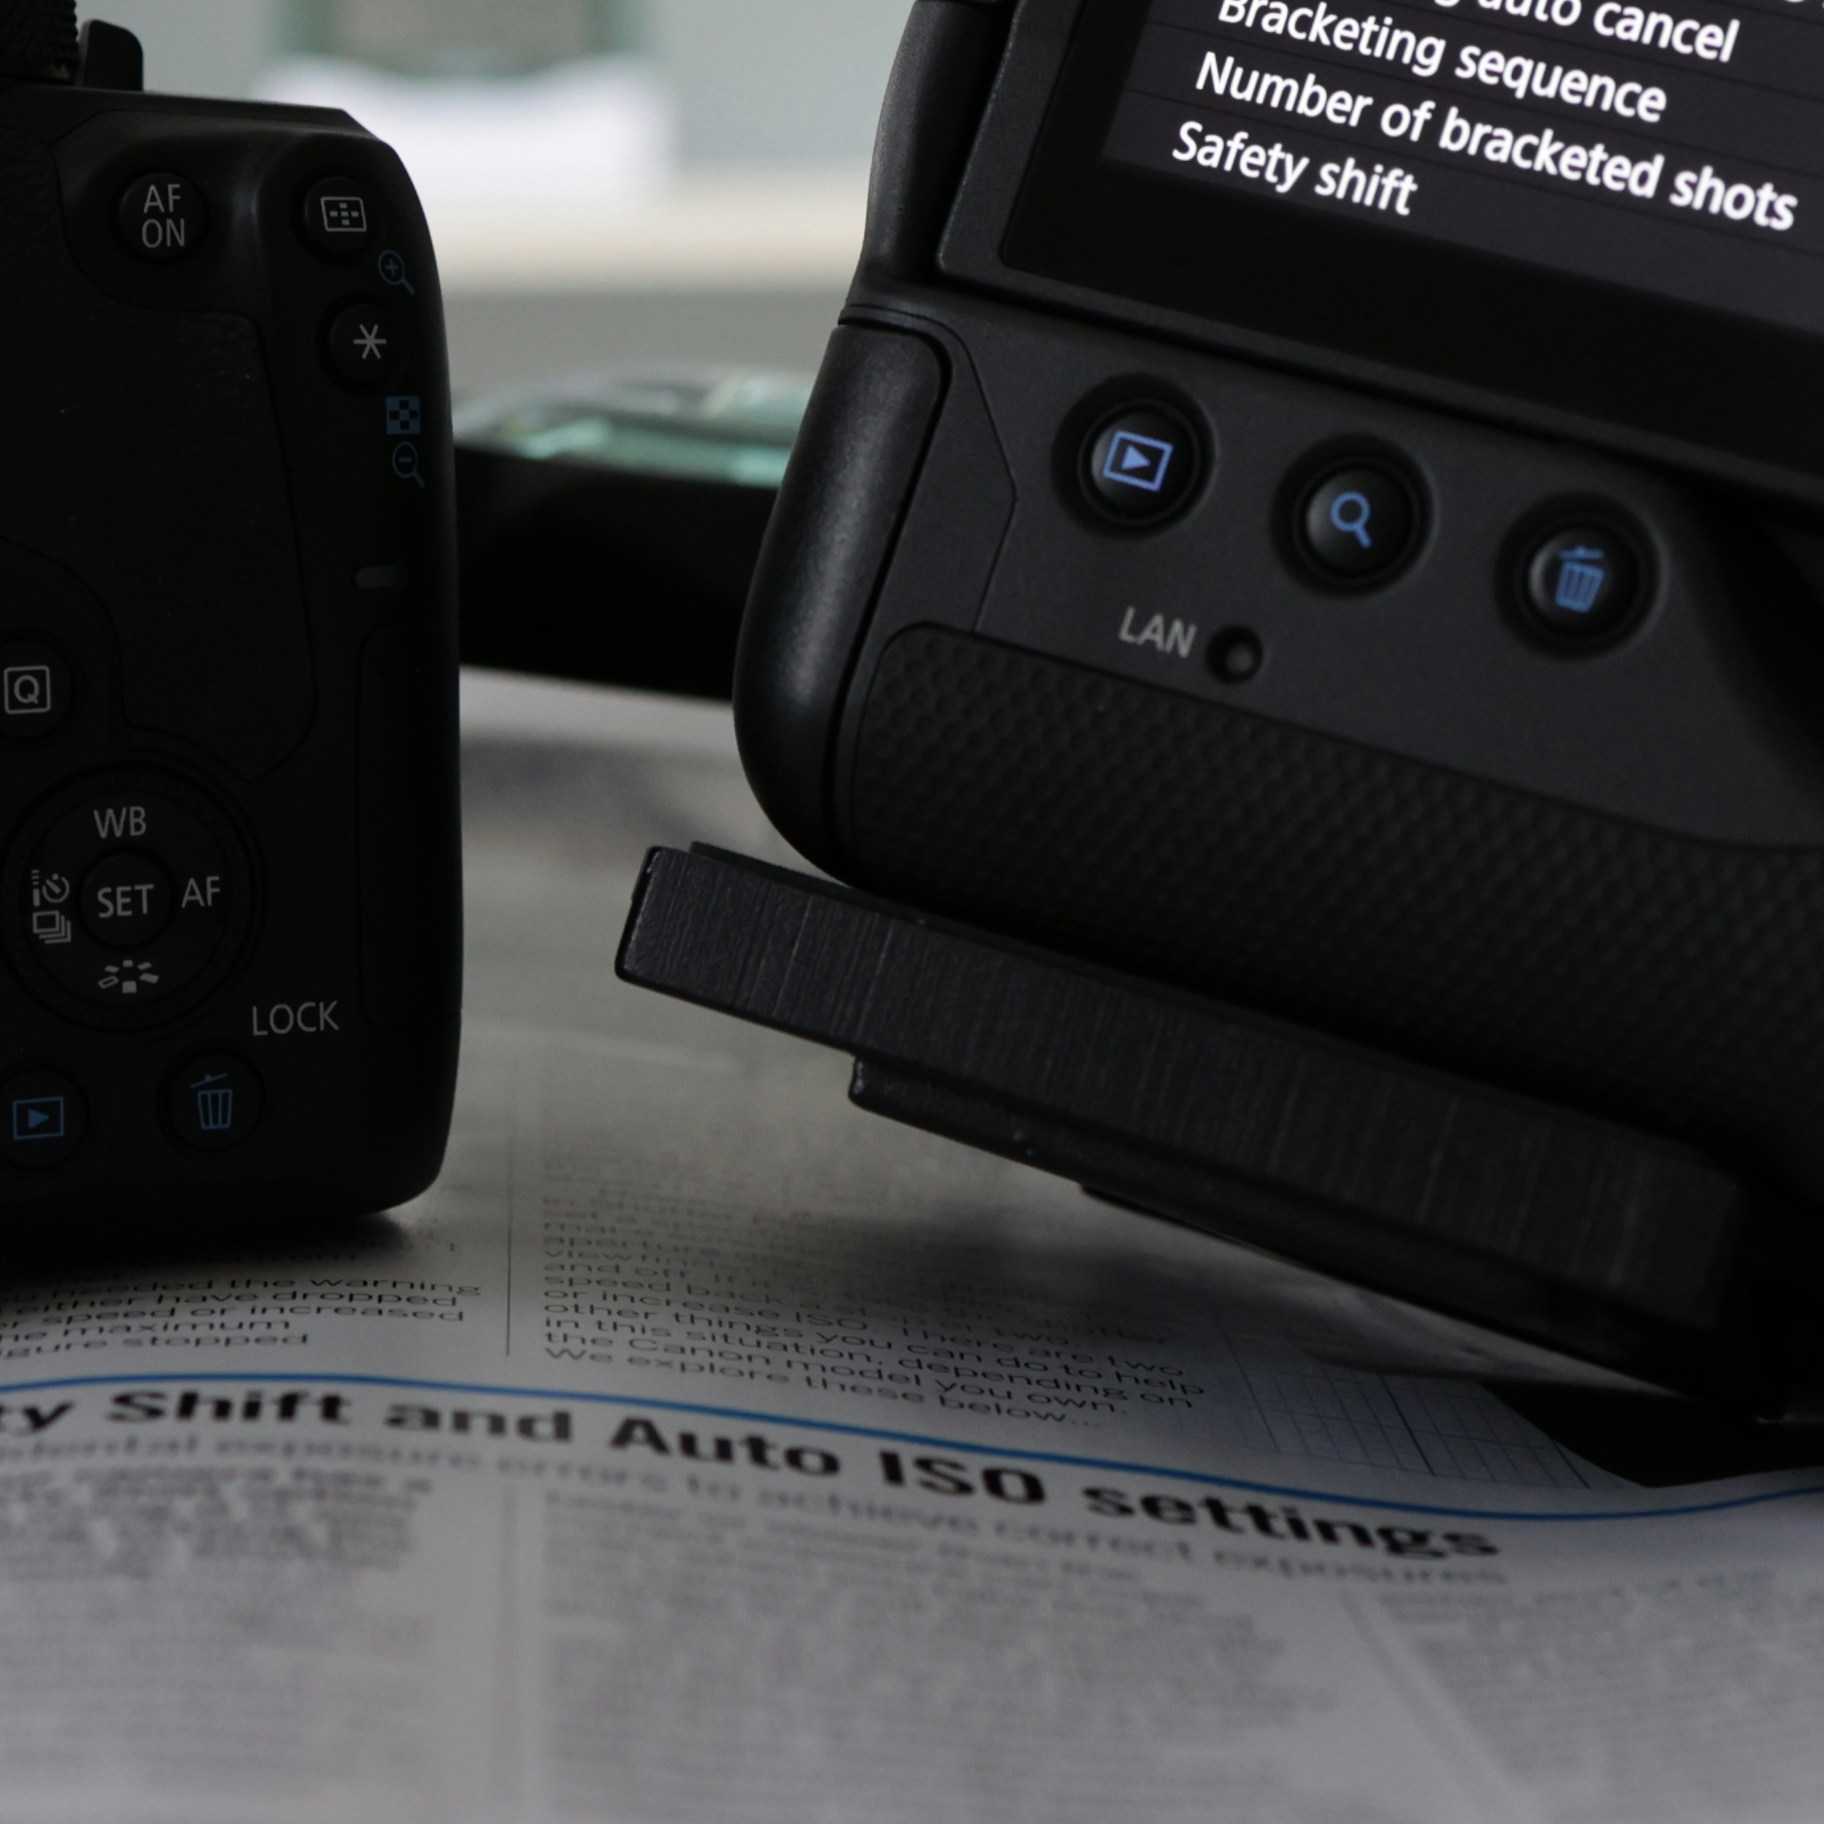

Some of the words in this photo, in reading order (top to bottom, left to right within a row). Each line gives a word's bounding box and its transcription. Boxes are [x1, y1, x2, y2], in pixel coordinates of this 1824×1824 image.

[1593, 1, 1741, 64] cancel
[1455, 45, 1668, 124] sequence
[1194, 51, 1374, 130] Number
[1380, 100, 1436, 143] of
[1439, 106, 1665, 199] bracketed
[1668, 166, 1799, 233] shots
[1172, 120, 1310, 195] Safety
[1314, 158, 1419, 217] shift
[141, 183, 183, 214] AF
[141, 216, 187, 250] ON
[1119, 604, 1197, 659] LAN
[92, 805, 148, 838] WB
[97, 883, 155, 919] SET
[180, 875, 222, 909] AF
[251, 1000, 340, 1037] LOCK
[157, 1291, 258, 1304] have
[272, 1290, 457, 1307] dropped
[229, 1278, 296, 1290] the
[309, 1278, 481, 1297] warning
[544, 1275, 672, 1293] speed
[42, 1307, 175, 1326] speed
[190, 1306, 238, 1317] or
[250, 1304, 464, 1322] increased
[64, 1320, 291, 1336] maximum
[544, 1288, 589, 1300] or
[601, 1289, 781, 1320] increase
[1028, 1347, 1094, 1364] are
[1107, 1355, 1184, 1377] two
[122, 1333, 308, 1349] stopped
[544, 1302, 658, 1321] other
[672, 1311, 804, 1340] things
[815, 1331, 894, 1351] you
[907, 1343, 983, 1364] can
[995, 1355, 1049, 1373] do
[1062, 1363, 1104, 1380] to
[1114, 1370, 1206, 1396] help
[544, 1316, 580, 1330] in
[596, 1319, 672, 1338] this
[897, 1356, 1129, 1402] depending
[1139, 1391, 1194, 1409] on
[544, 1331, 614, 1347] the
[627, 1338, 772, 1366] Canon
[785, 1358, 923, 1387] model
[935, 1379, 1014, 1401] you
[1026, 1390, 1129, 1416] own.
[544, 1347, 613, 1364] We
[627, 1356, 790, 1385] explore
[804, 1376, 926, 1405] these
[105, 1389, 352, 1427] Shift
[384, 1402, 573, 1444] and
[610, 1415, 842, 1478] Auto
[877, 1448, 1046, 1506] ISO
[1081, 1480, 1500, 1560] settings
[994, 1515, 1198, 1567] correct
